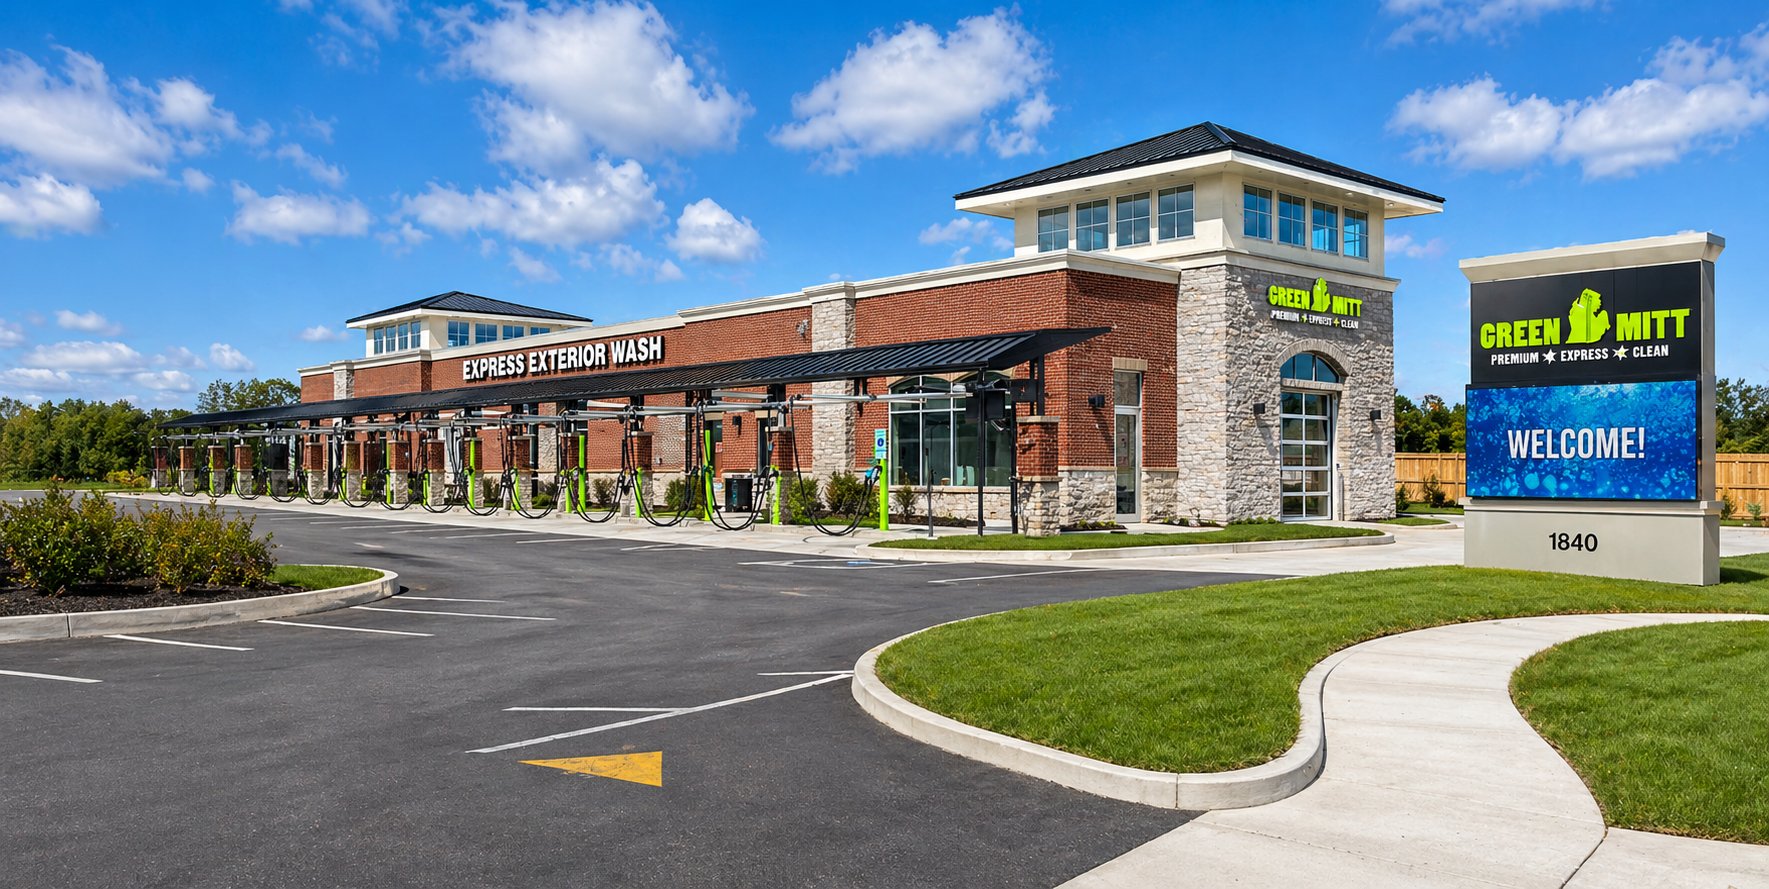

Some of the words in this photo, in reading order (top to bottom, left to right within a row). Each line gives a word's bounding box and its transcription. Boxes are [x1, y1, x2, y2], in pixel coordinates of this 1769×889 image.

[1269, 285, 1310, 310] GREEN
[1332, 295, 1363, 317] MITT
[1341, 319, 1359, 329] CLEAN
[1480, 317, 1561, 349] GREEN
[1616, 308, 1690, 342] MITT
[463, 353, 525, 380] EXPRESS
[529, 343, 606, 373] EXTERIOR
[611, 336, 662, 364] WASH
[1491, 352, 1539, 366] PREMIUM
[1560, 347, 1609, 362] EXPRESS
[1633, 345, 1669, 358] CLEAN
[1507, 427, 1645, 459] WELCOME!
[1549, 532, 1598, 552] 1840
